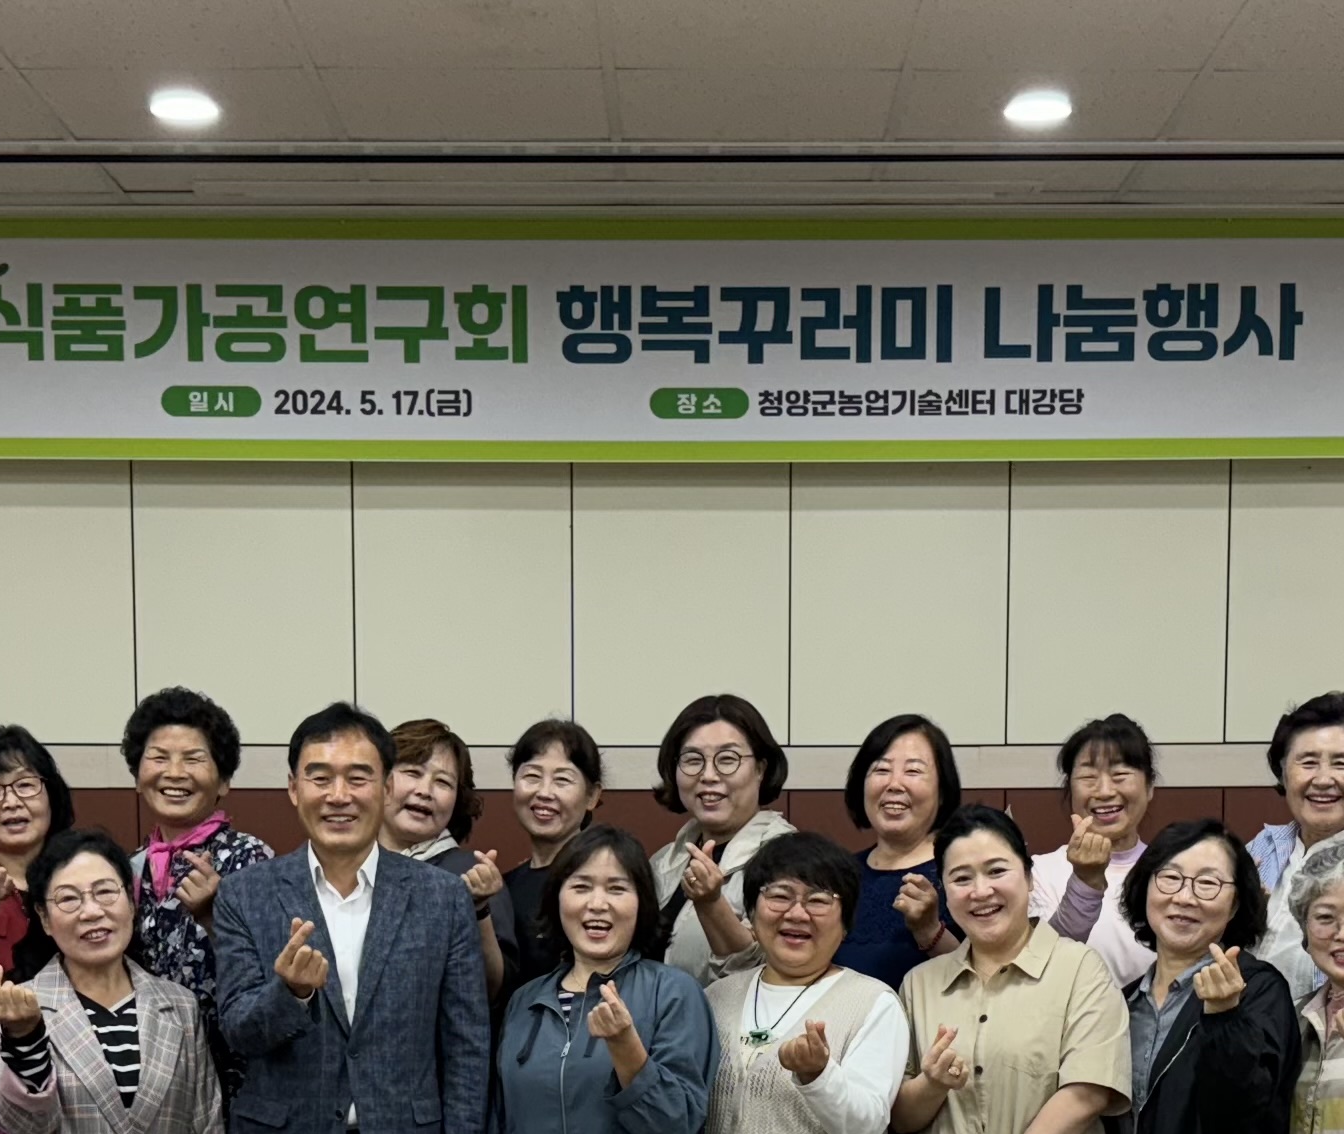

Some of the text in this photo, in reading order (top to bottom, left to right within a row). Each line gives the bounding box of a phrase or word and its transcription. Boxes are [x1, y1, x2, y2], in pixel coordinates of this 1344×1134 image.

[555, 281, 955, 365] 행복꾸러미
[983, 281, 1302, 365] 나눔행사
[273, 388, 351, 417] 2024.
[757, 389, 1085, 420] 청양군농업기술센터 대강당
